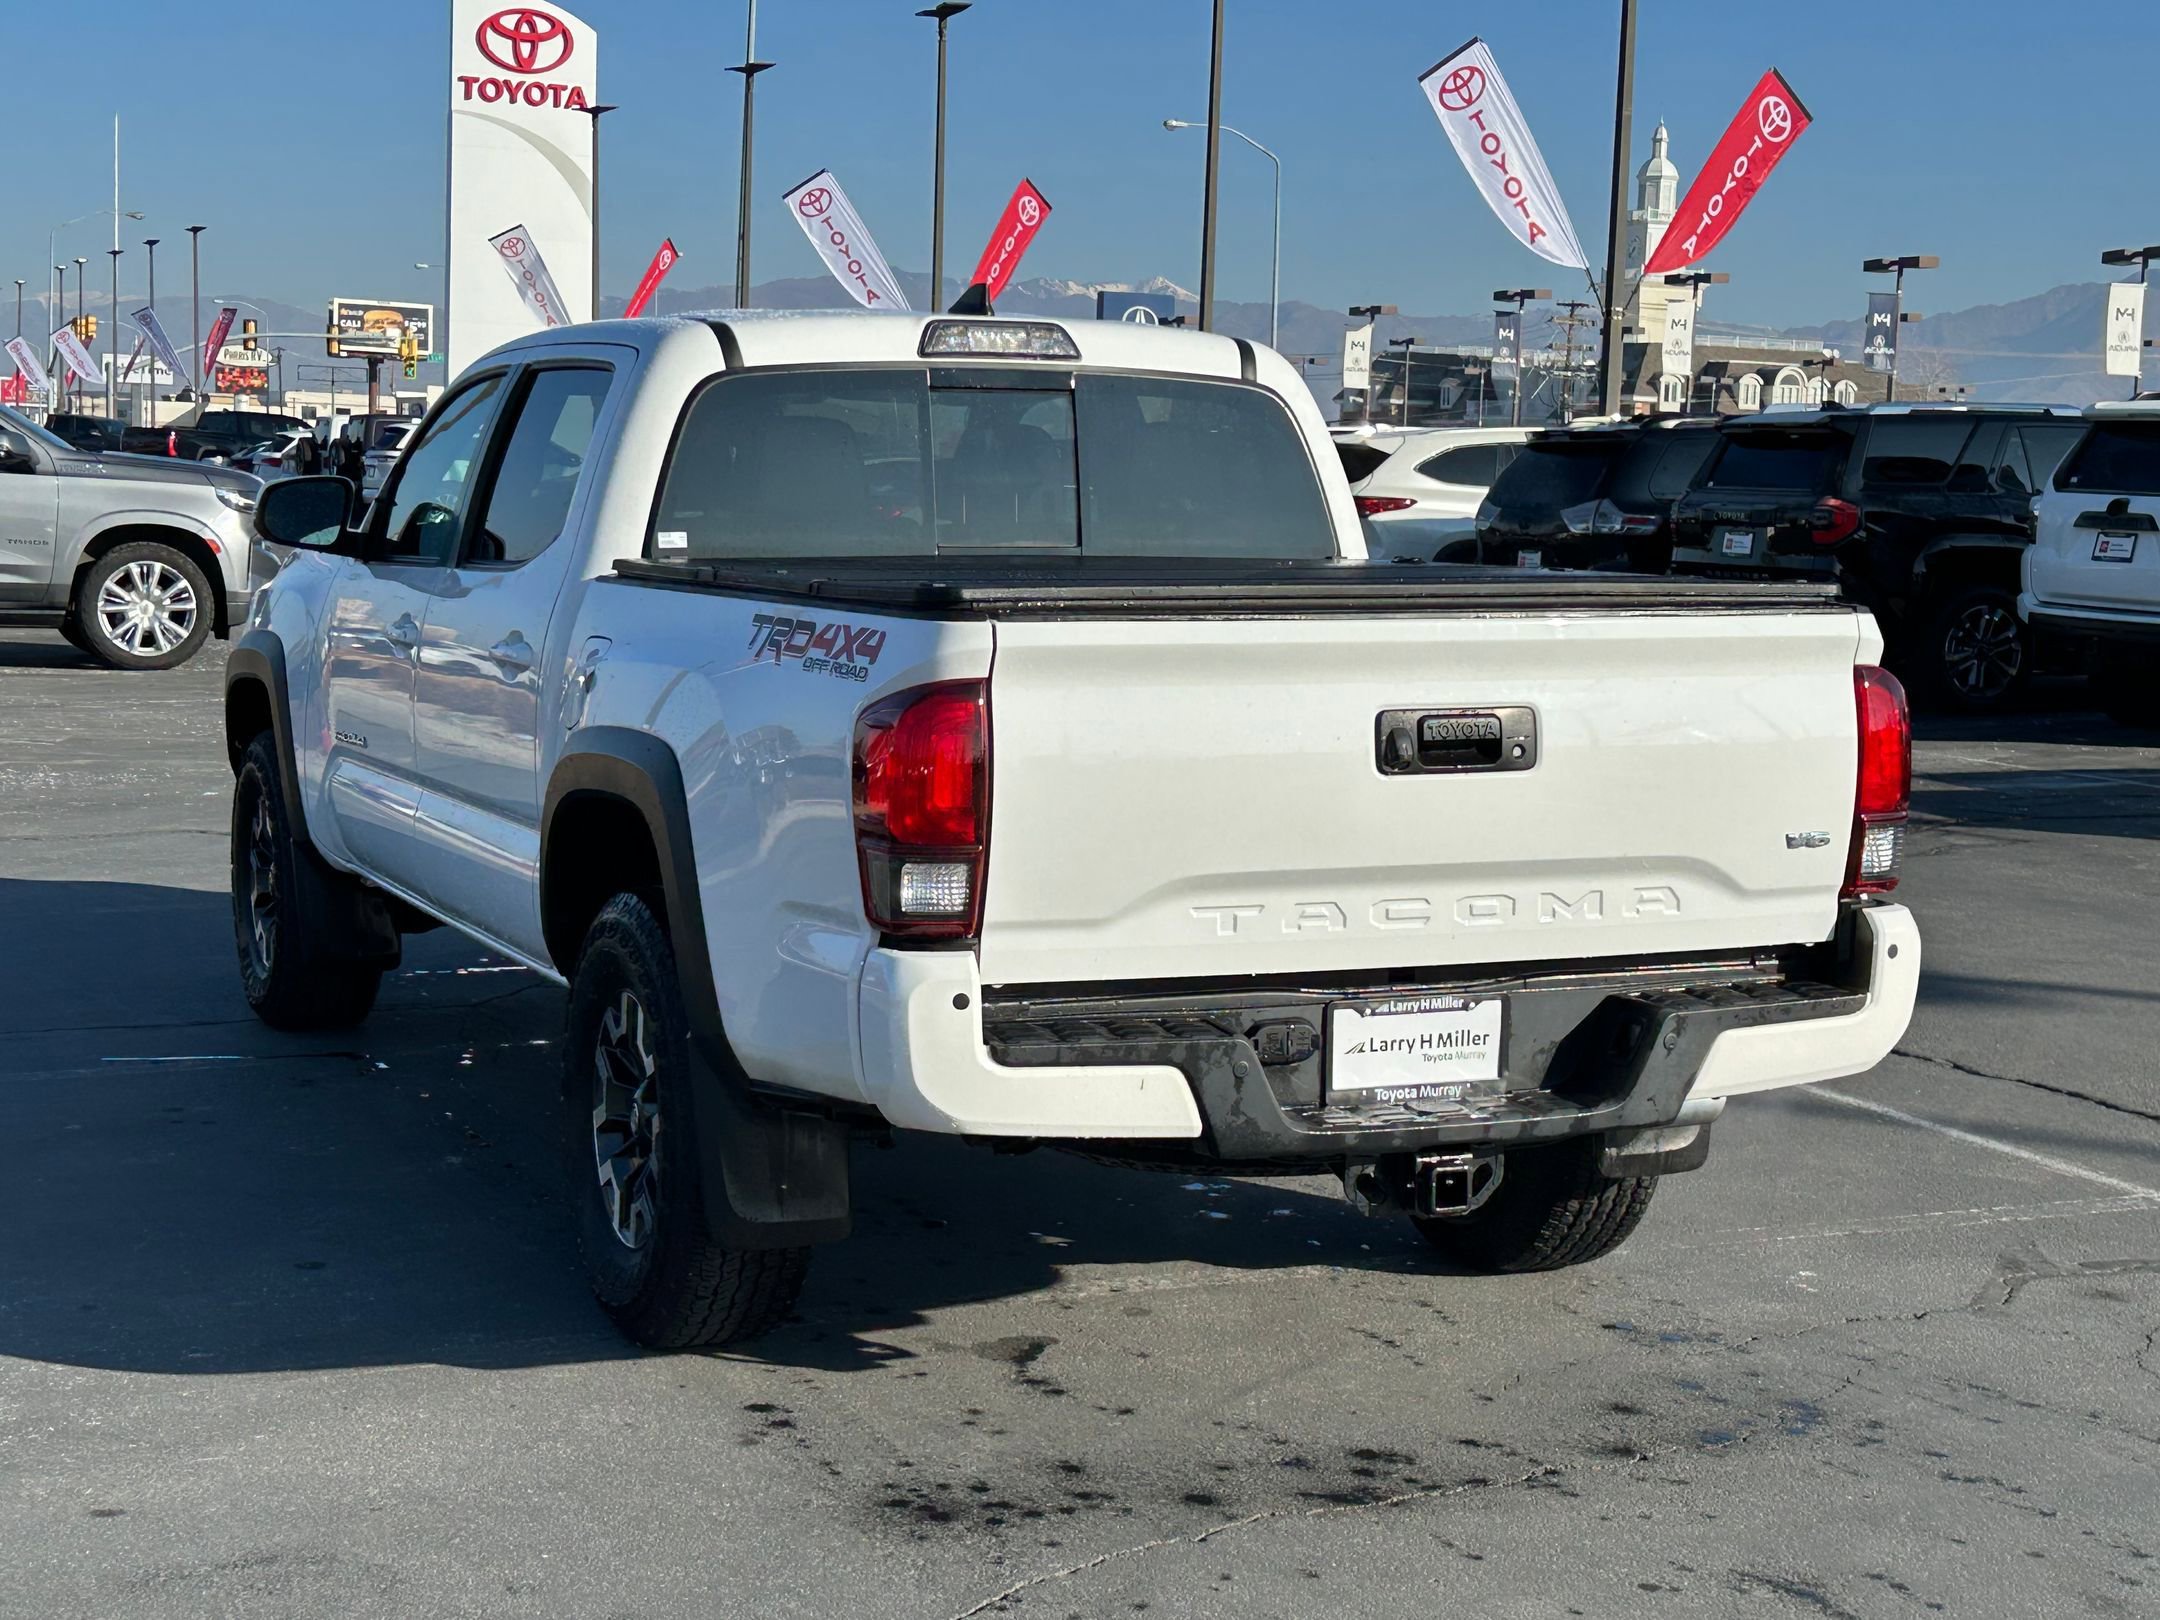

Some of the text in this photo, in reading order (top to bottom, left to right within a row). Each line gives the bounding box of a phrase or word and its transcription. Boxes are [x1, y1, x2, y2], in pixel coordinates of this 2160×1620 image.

[457, 76, 587, 109] TOYOTA
[1469, 110, 1546, 244] TOYOTA
[1681, 135, 1763, 258] TOYOTA
[820, 216, 880, 304] TOYOTA
[987, 222, 1023, 285] TOYOT
[516, 259, 557, 326] TOYOTA
[1864, 346, 1895, 355] ACURA
[802, 657, 869, 682] OFF ROAD
[1427, 719, 1497, 740] TOYOTA
[1785, 831, 1831, 850] V6
[1189, 886, 1680, 936] TACOMA
[1390, 997, 1465, 1012] Larry H Miller
[1369, 1029, 1490, 1054] Larry H Miller
[1422, 1051, 1486, 1063] Toyota Murray
[1375, 1084, 1462, 1103] Toyota Murray
